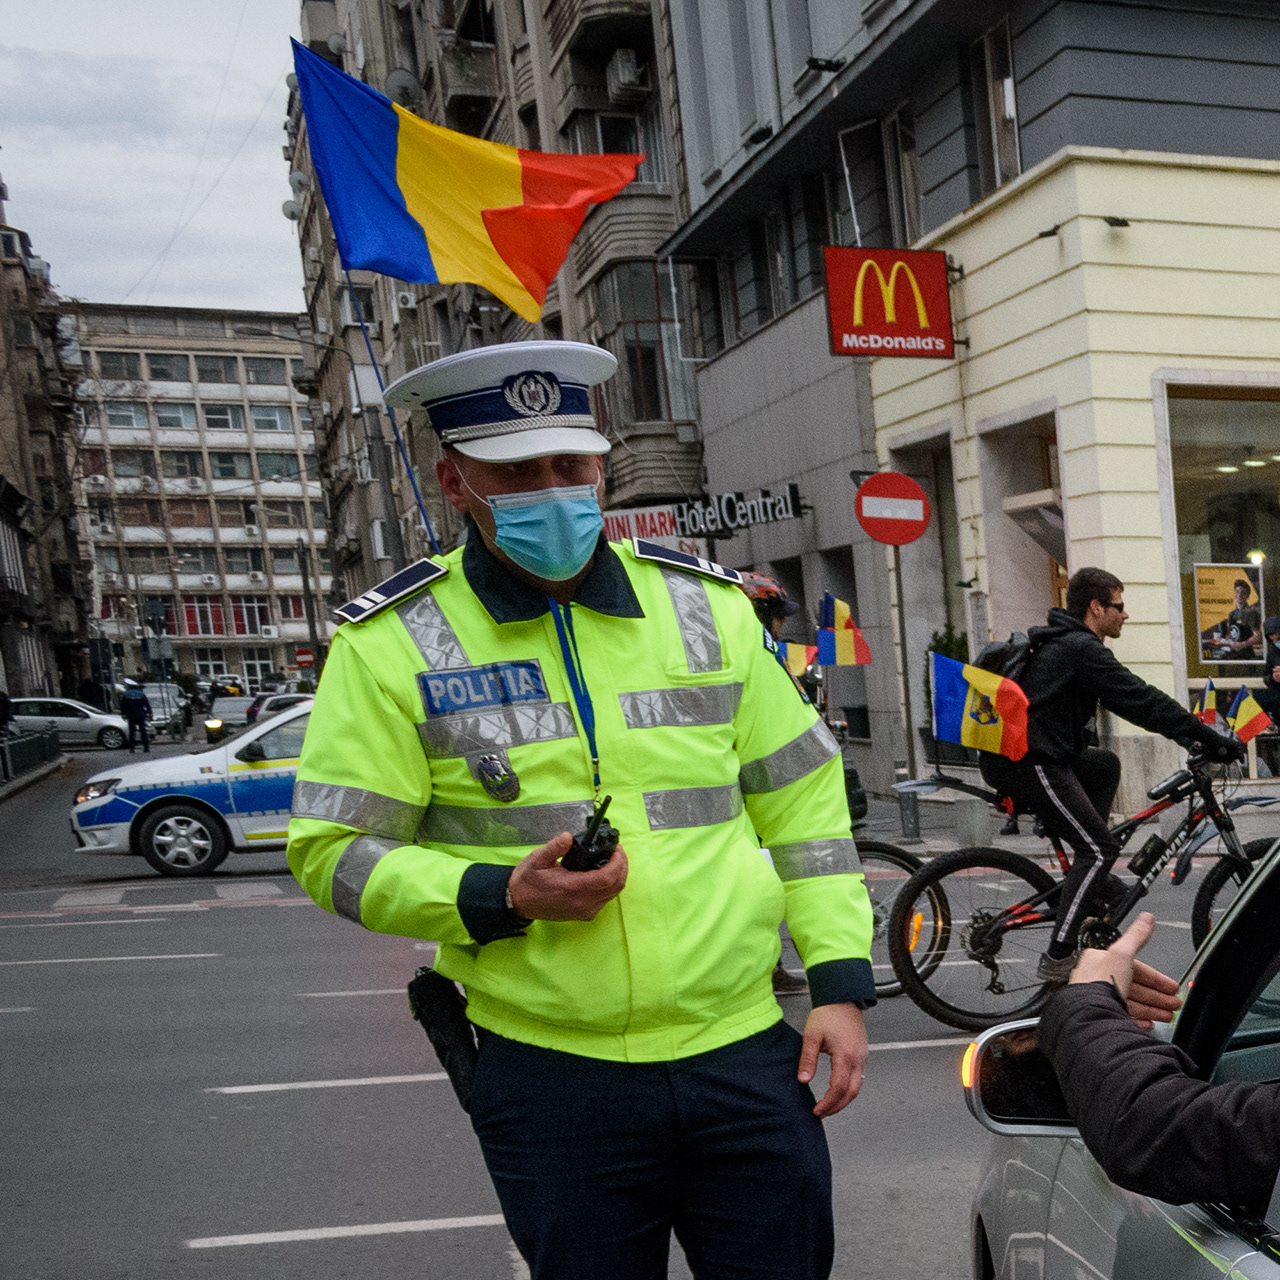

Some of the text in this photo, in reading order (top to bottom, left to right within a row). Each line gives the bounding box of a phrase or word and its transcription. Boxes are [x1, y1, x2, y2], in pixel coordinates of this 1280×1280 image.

[842, 333, 945, 350] McDonald's
[674, 485, 794, 536] Hotel Central
